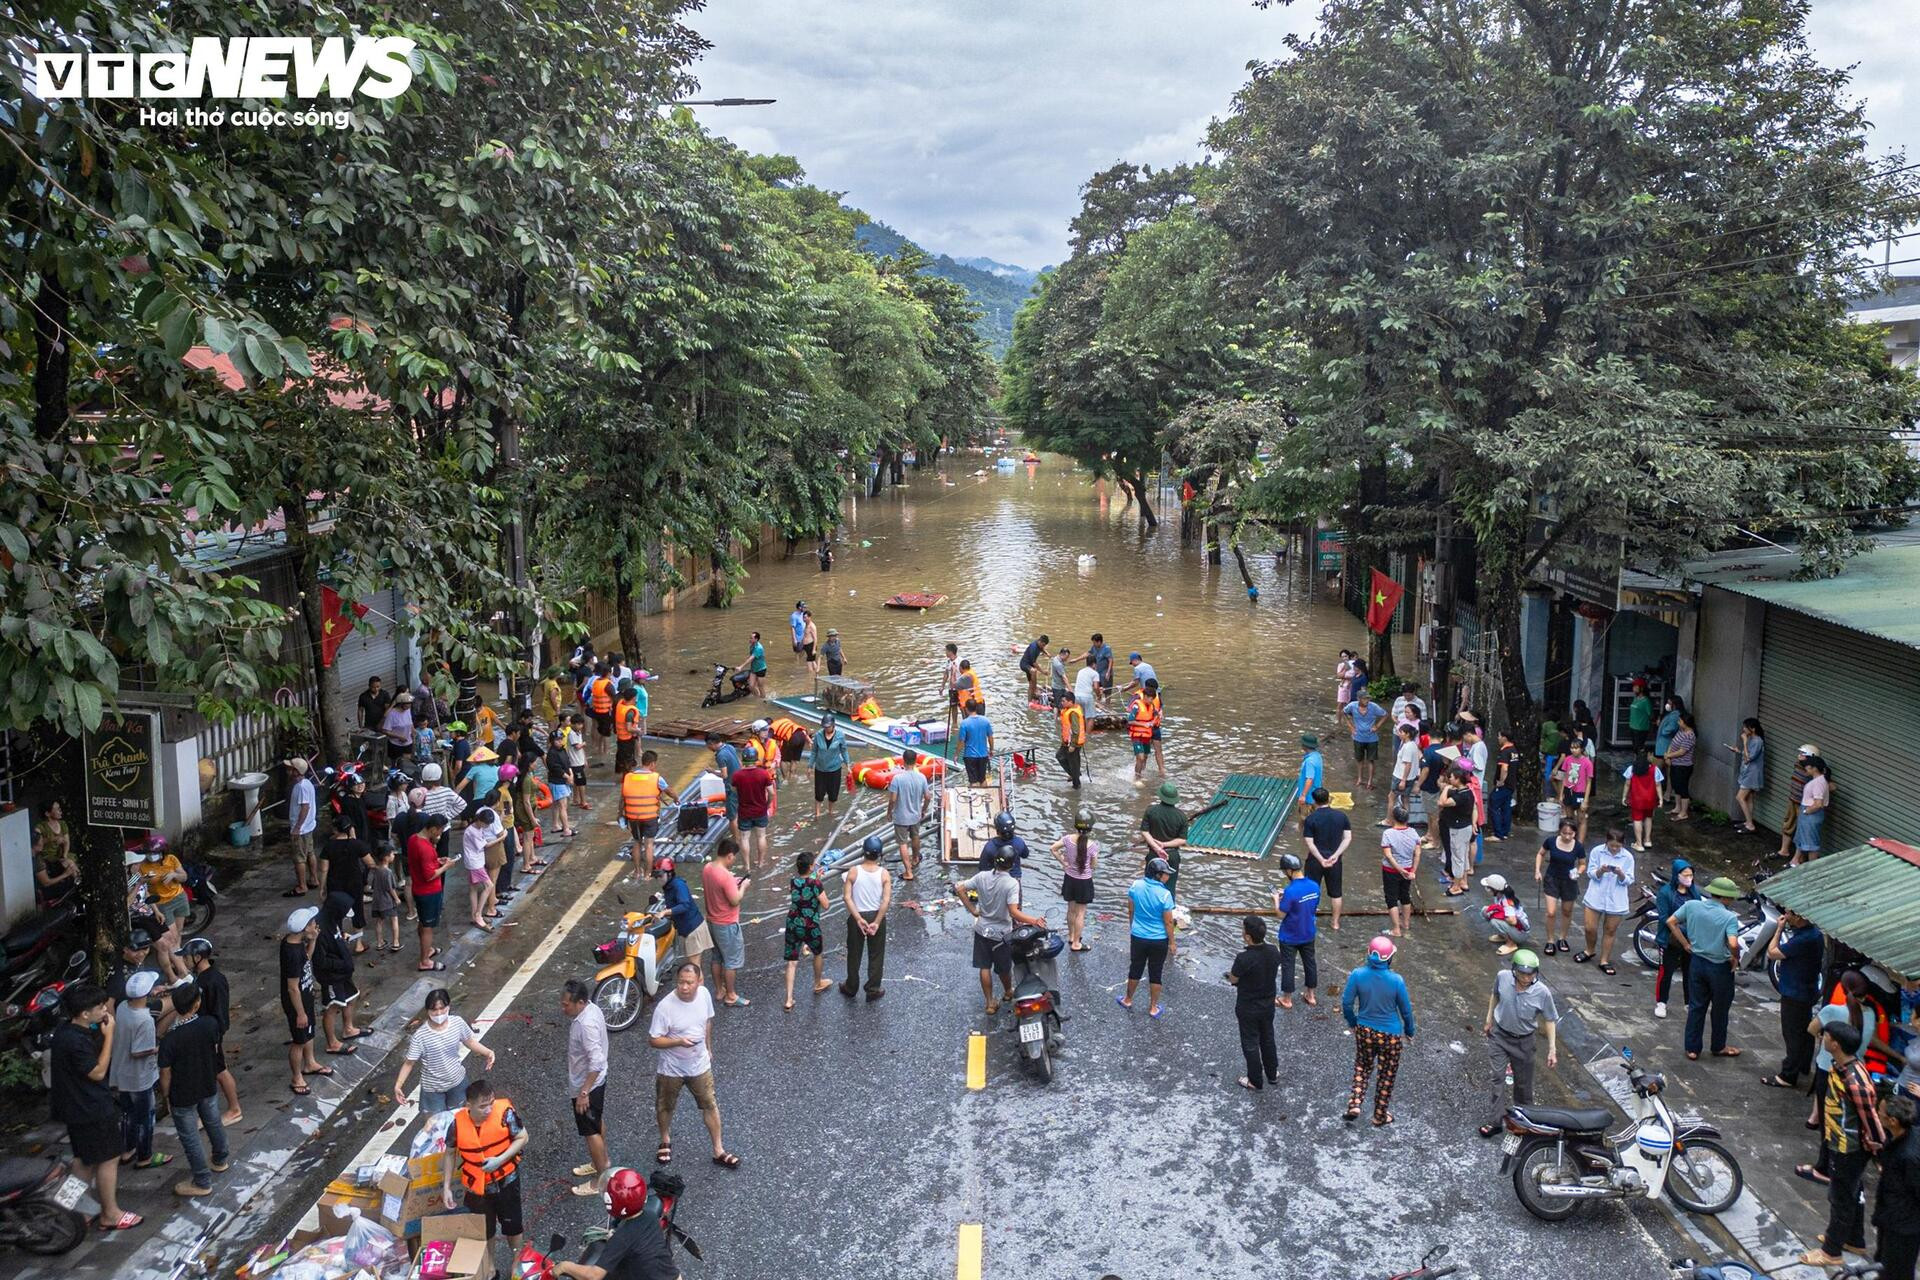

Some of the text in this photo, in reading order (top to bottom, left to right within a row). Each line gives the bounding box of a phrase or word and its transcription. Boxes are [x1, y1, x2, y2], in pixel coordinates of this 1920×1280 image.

[112, 748, 149, 765] Chanh
[91, 796, 117, 807] COFFEE
[122, 798, 139, 809] SINH
